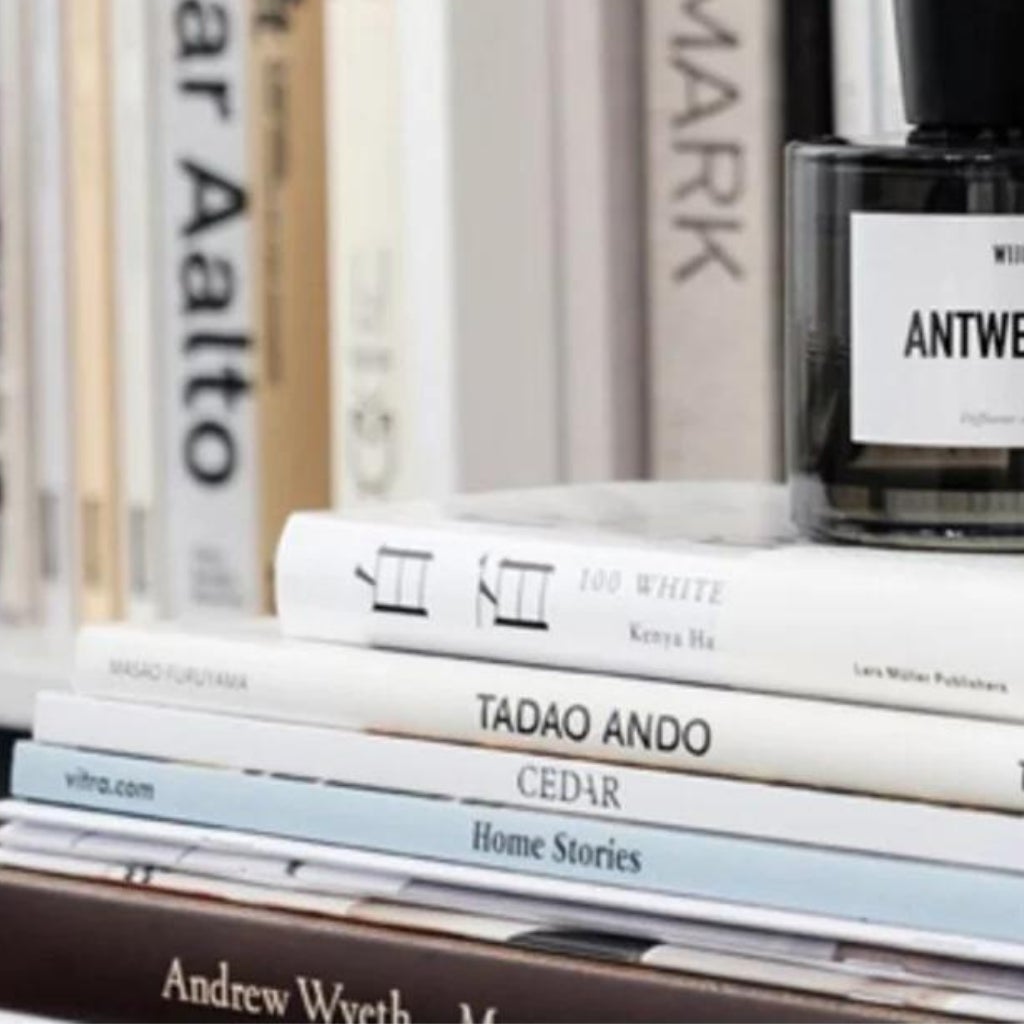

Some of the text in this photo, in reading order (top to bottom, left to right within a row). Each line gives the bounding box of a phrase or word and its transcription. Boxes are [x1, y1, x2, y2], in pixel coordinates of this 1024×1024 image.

[179, 156, 253, 488] Aalto
[577, 566, 624, 594] 100
[628, 621, 683, 650] Kenya
[476, 692, 712, 757] TADAO ANDO
[64, 765, 156, 802] vitra.com
[515, 764, 623, 810] CEDAR
[471, 819, 643, 874] Home Stories
[160, 957, 291, 1017] Andrew
